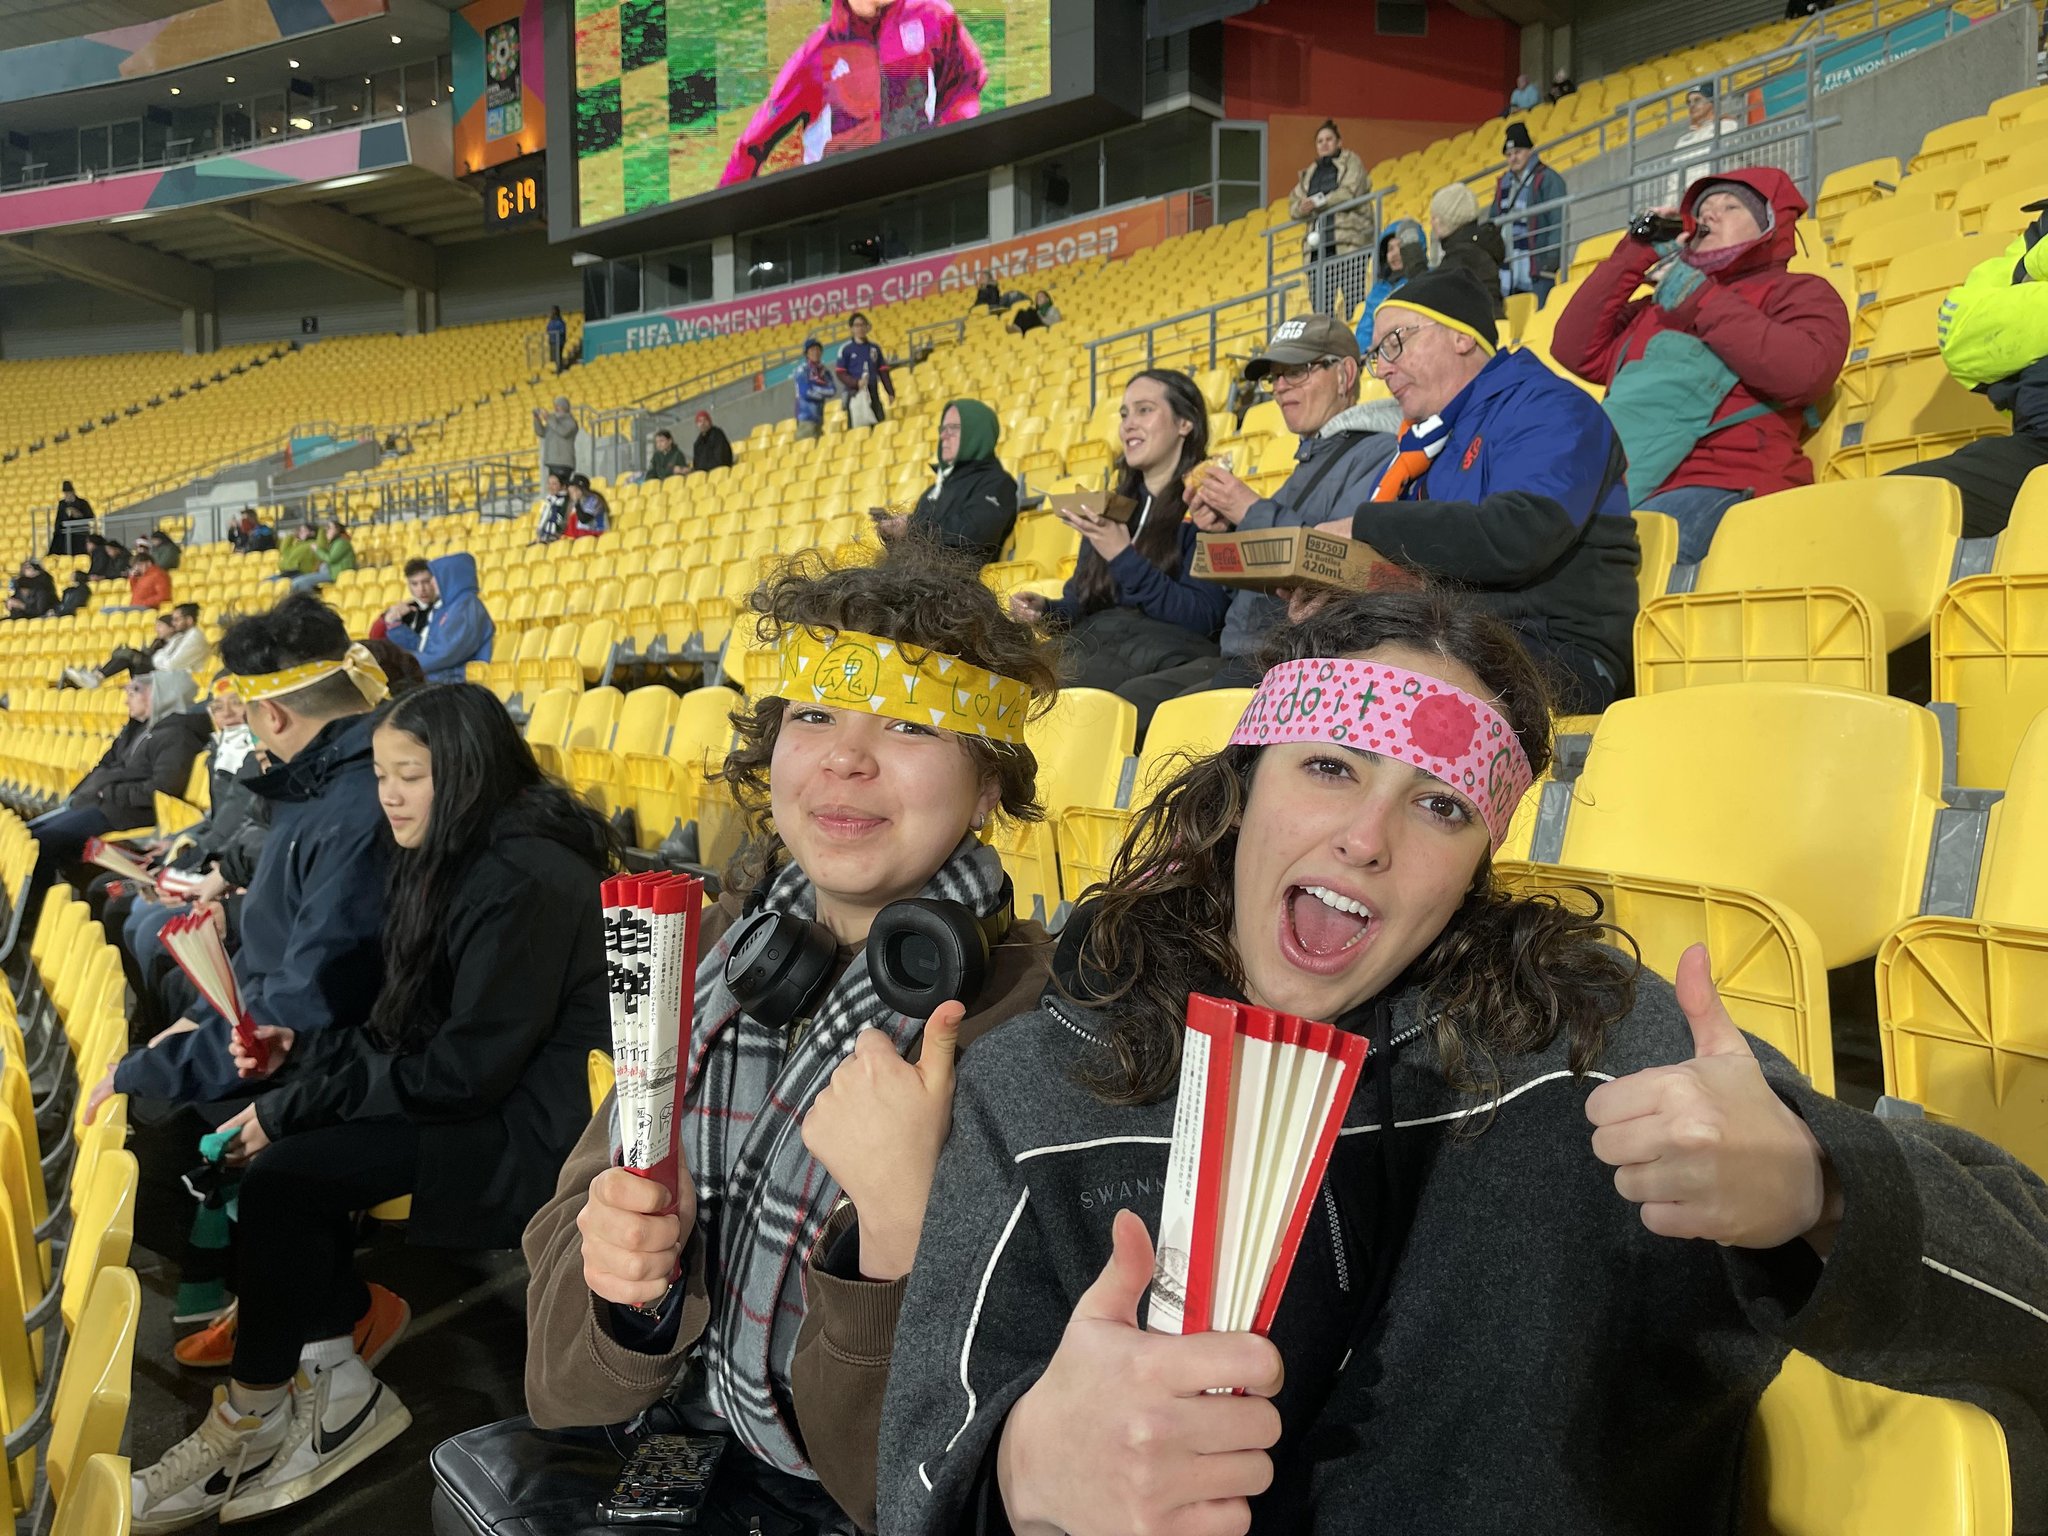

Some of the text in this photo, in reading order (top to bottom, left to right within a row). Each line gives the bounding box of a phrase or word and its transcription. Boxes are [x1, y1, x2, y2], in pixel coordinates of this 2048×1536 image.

[497, 177, 536, 219] 6:19
[626, 322, 672, 350] FIFA
[675, 301, 782, 342] WOMEN'S
[788, 284, 873, 320] WORLD
[881, 270, 933, 302] CUP
[1309, 539, 1344, 556] 987503
